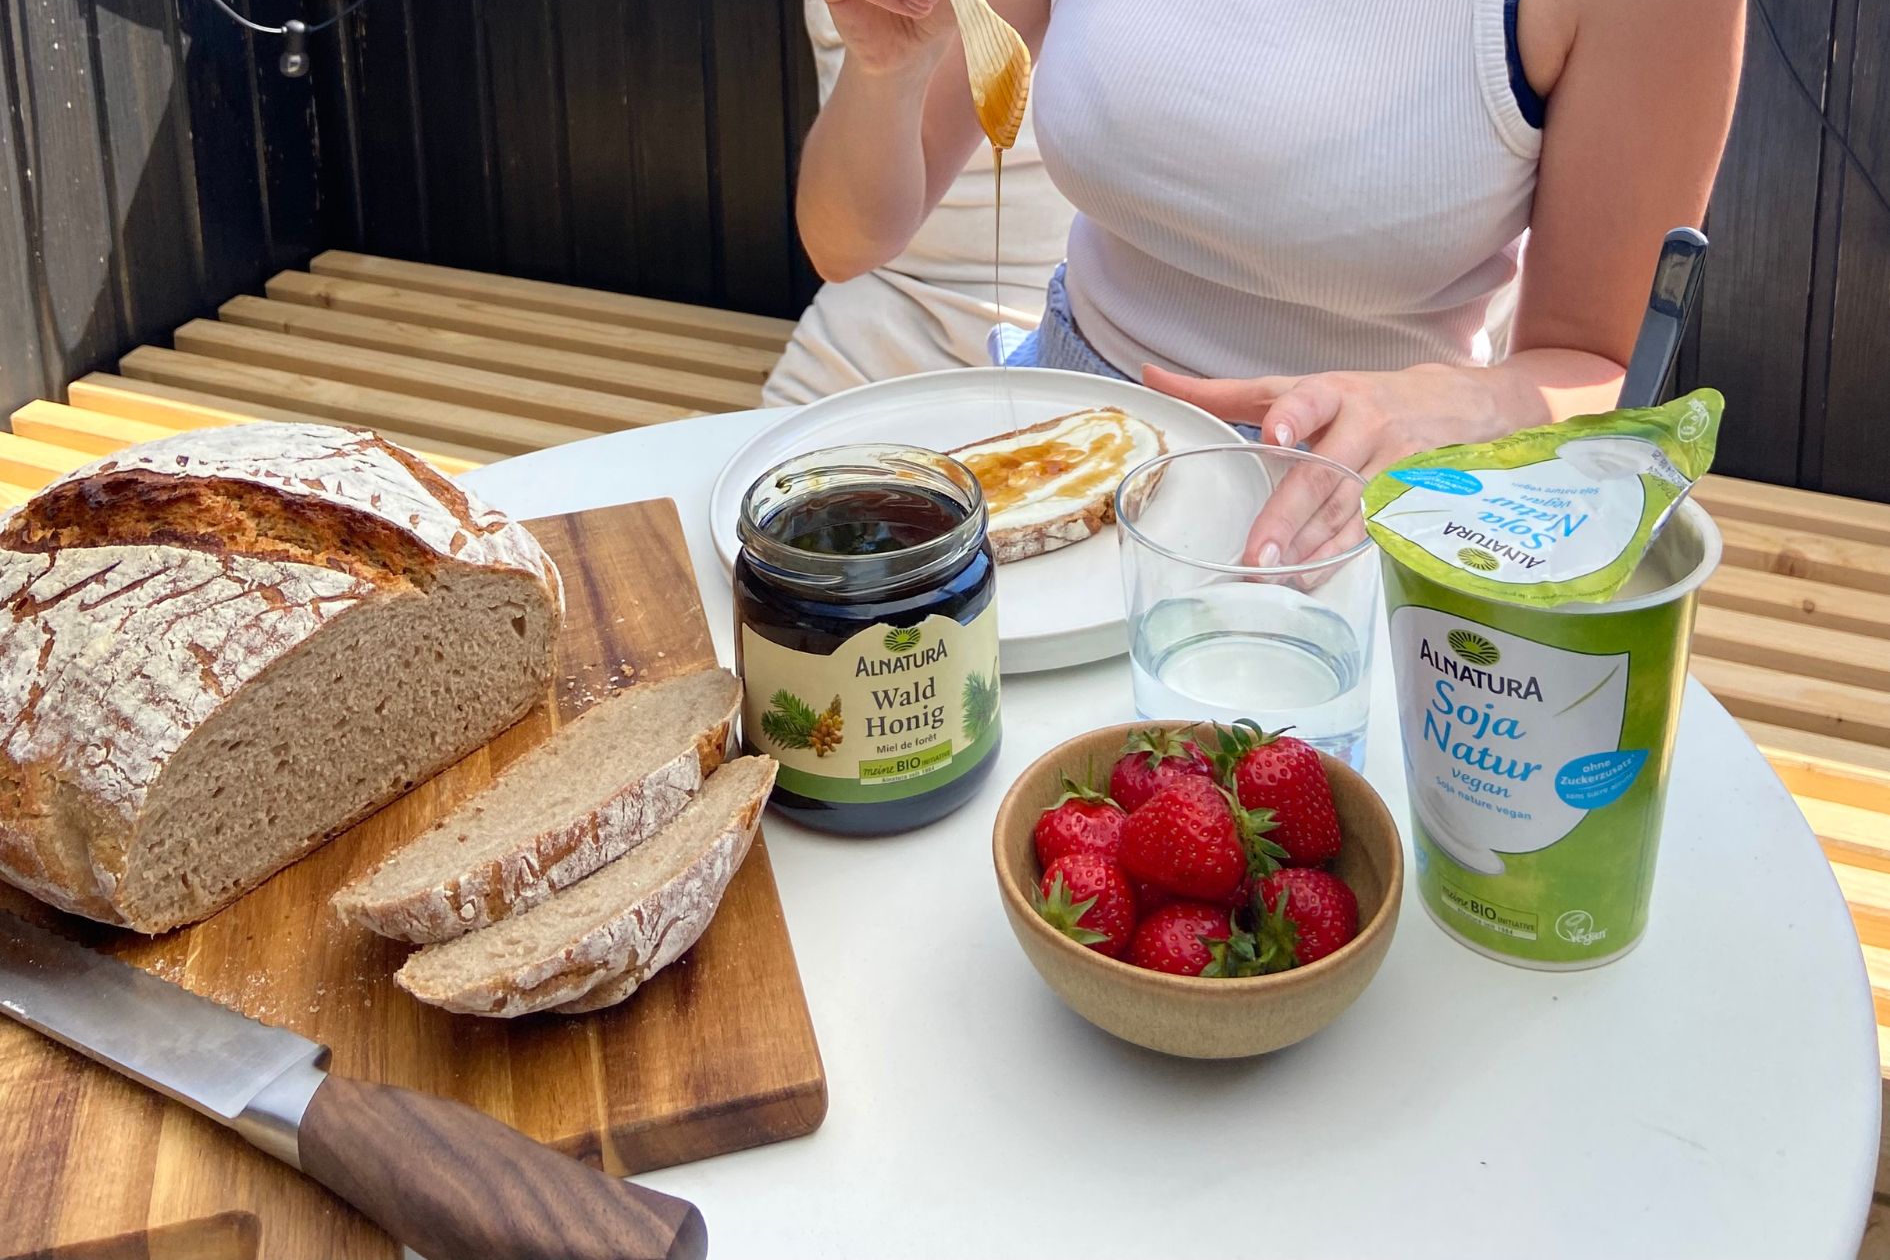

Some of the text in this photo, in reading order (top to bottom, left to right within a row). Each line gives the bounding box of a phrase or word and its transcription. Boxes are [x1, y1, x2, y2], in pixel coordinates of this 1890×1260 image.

[1482, 497, 1589, 537] Natur
[1520, 495, 1571, 508] vegan
[1443, 521, 1546, 569] ALNATURA
[1478, 511, 1556, 550] Soja
[855, 638, 948, 678] ALNATURA
[1420, 638, 1543, 702] ALNATURA
[872, 676, 936, 710] Wald
[1432, 680, 1526, 739] Soja
[865, 703, 945, 738] Honig
[876, 733, 937, 754] Miel de forêt
[1424, 708, 1542, 782] Natur
[863, 765, 895, 776] meine
[896, 757, 920, 772] BIO
[1452, 767, 1512, 798] vegan
[1583, 760, 1611, 773] ohne
[1457, 790, 1492, 810] nature
[1496, 805, 1532, 821] vegan
[1471, 900, 1496, 920] BIO
